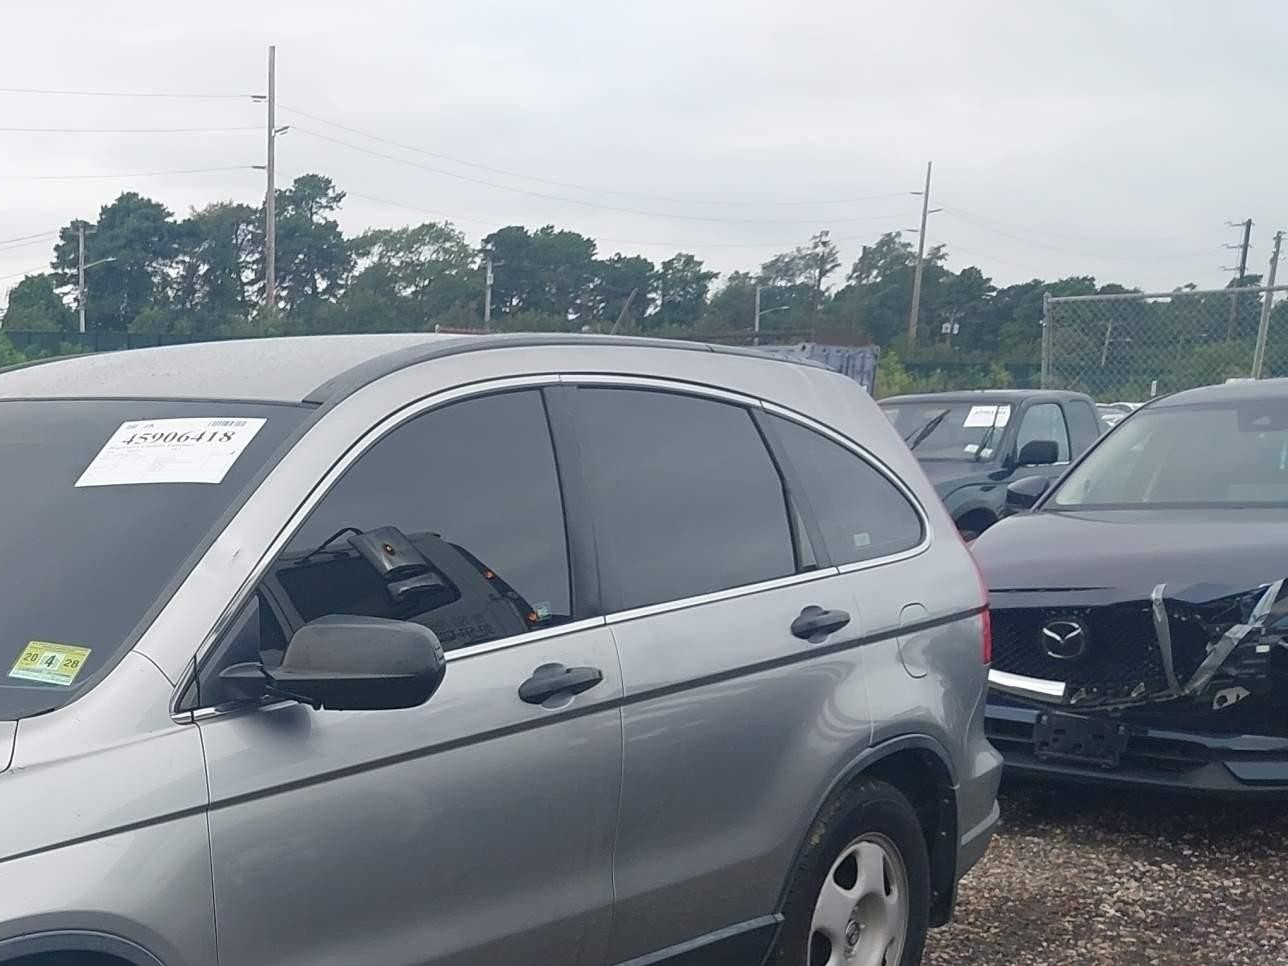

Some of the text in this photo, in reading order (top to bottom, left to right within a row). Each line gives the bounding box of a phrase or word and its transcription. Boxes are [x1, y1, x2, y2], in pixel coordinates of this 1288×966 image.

[122, 430, 236, 445] 45906418
[23, 652, 80, 669] 20 4 28
